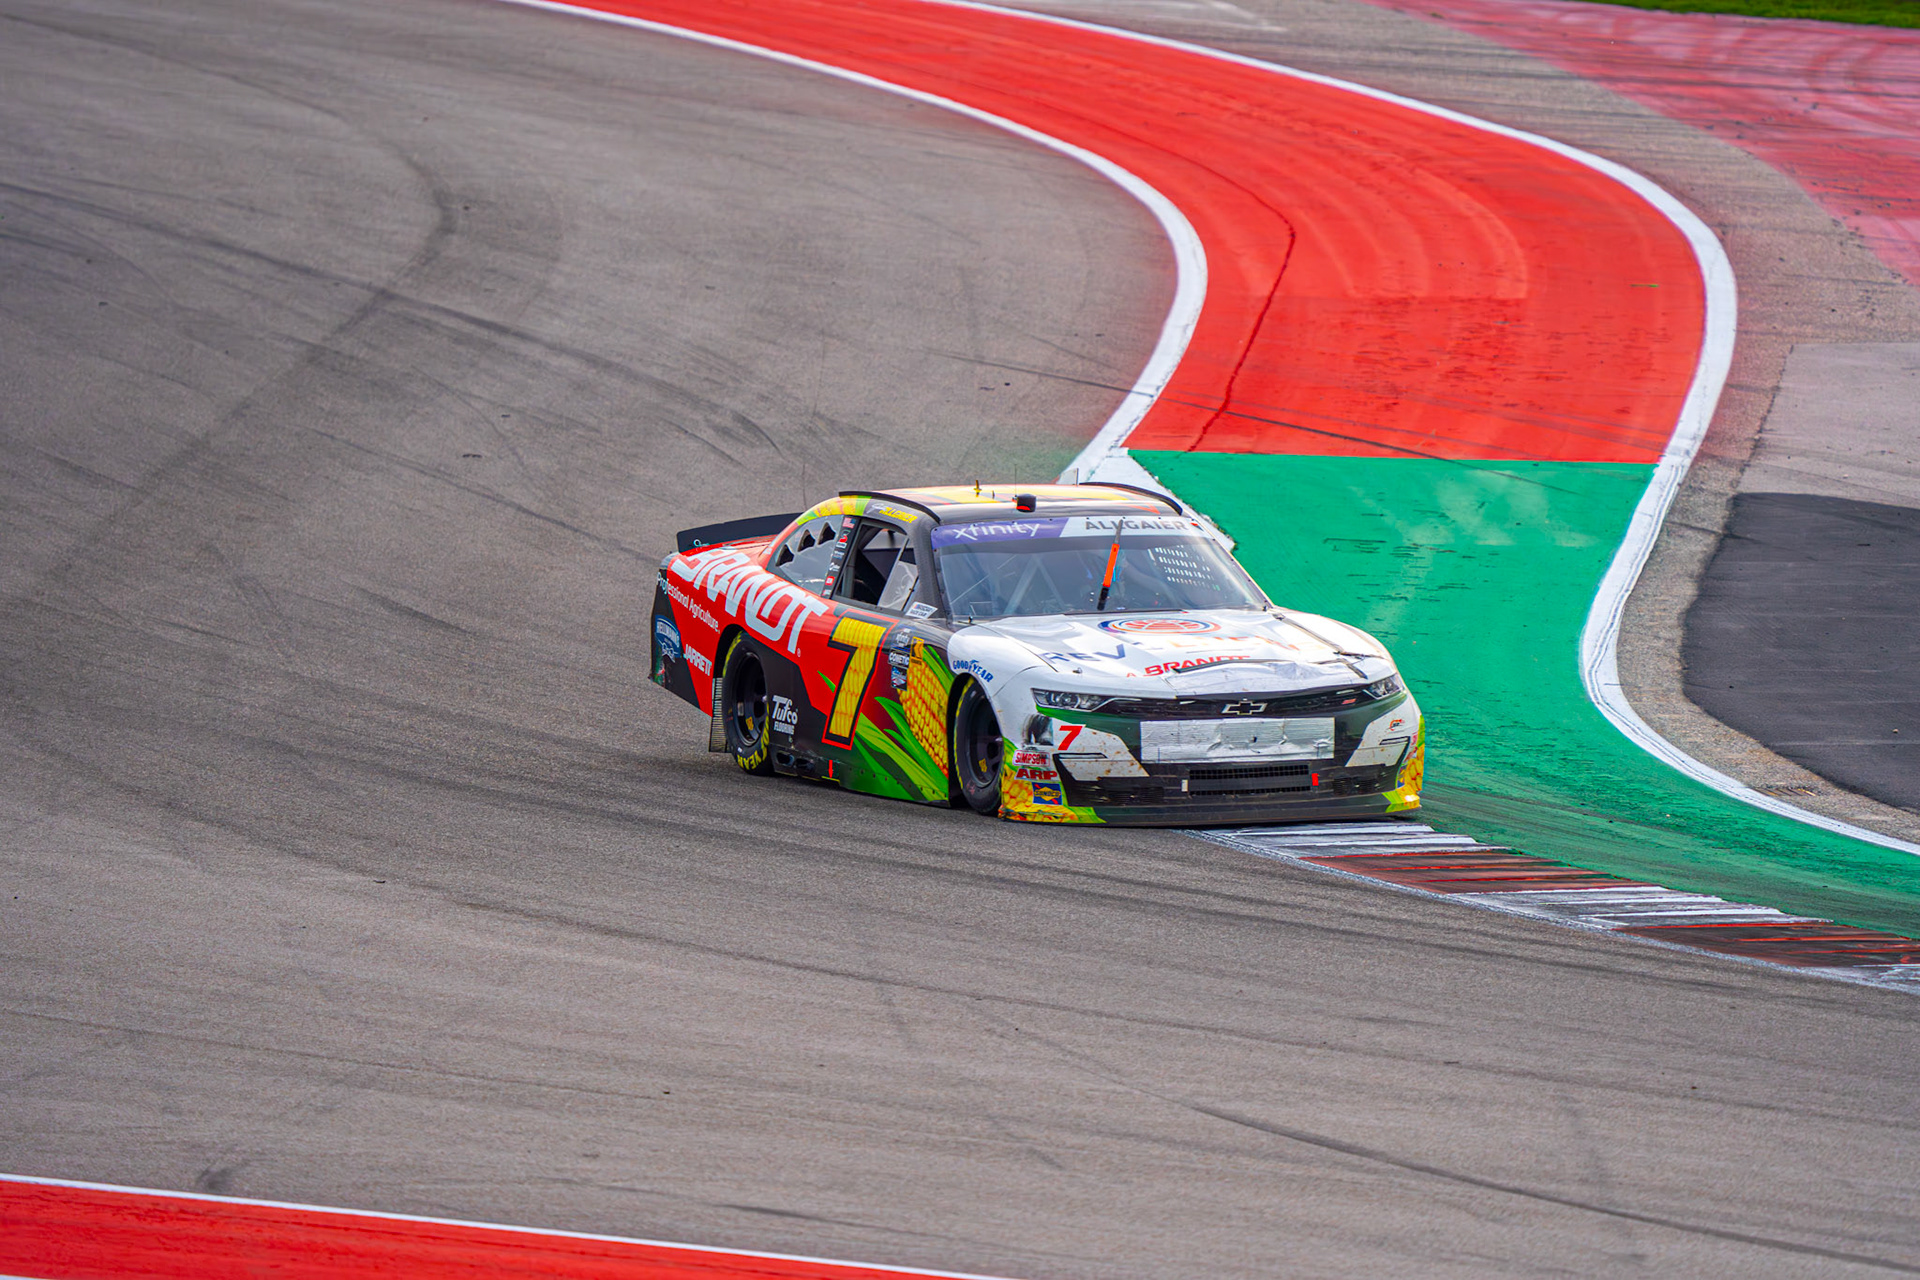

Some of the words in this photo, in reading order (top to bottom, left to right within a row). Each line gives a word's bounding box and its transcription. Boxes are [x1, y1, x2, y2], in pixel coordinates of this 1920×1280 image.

[953, 521, 1041, 541] xfinity
[656, 571, 690, 609] Professional
[670, 546, 829, 653] BRANDT
[683, 643, 712, 677] JARRETT
[827, 616, 887, 744] 7
[772, 694, 798, 725] Tufco
[1058, 725, 1083, 751] 7
[1015, 752, 1048, 765] SIMPSON
[1016, 768, 1059, 780] ARP
